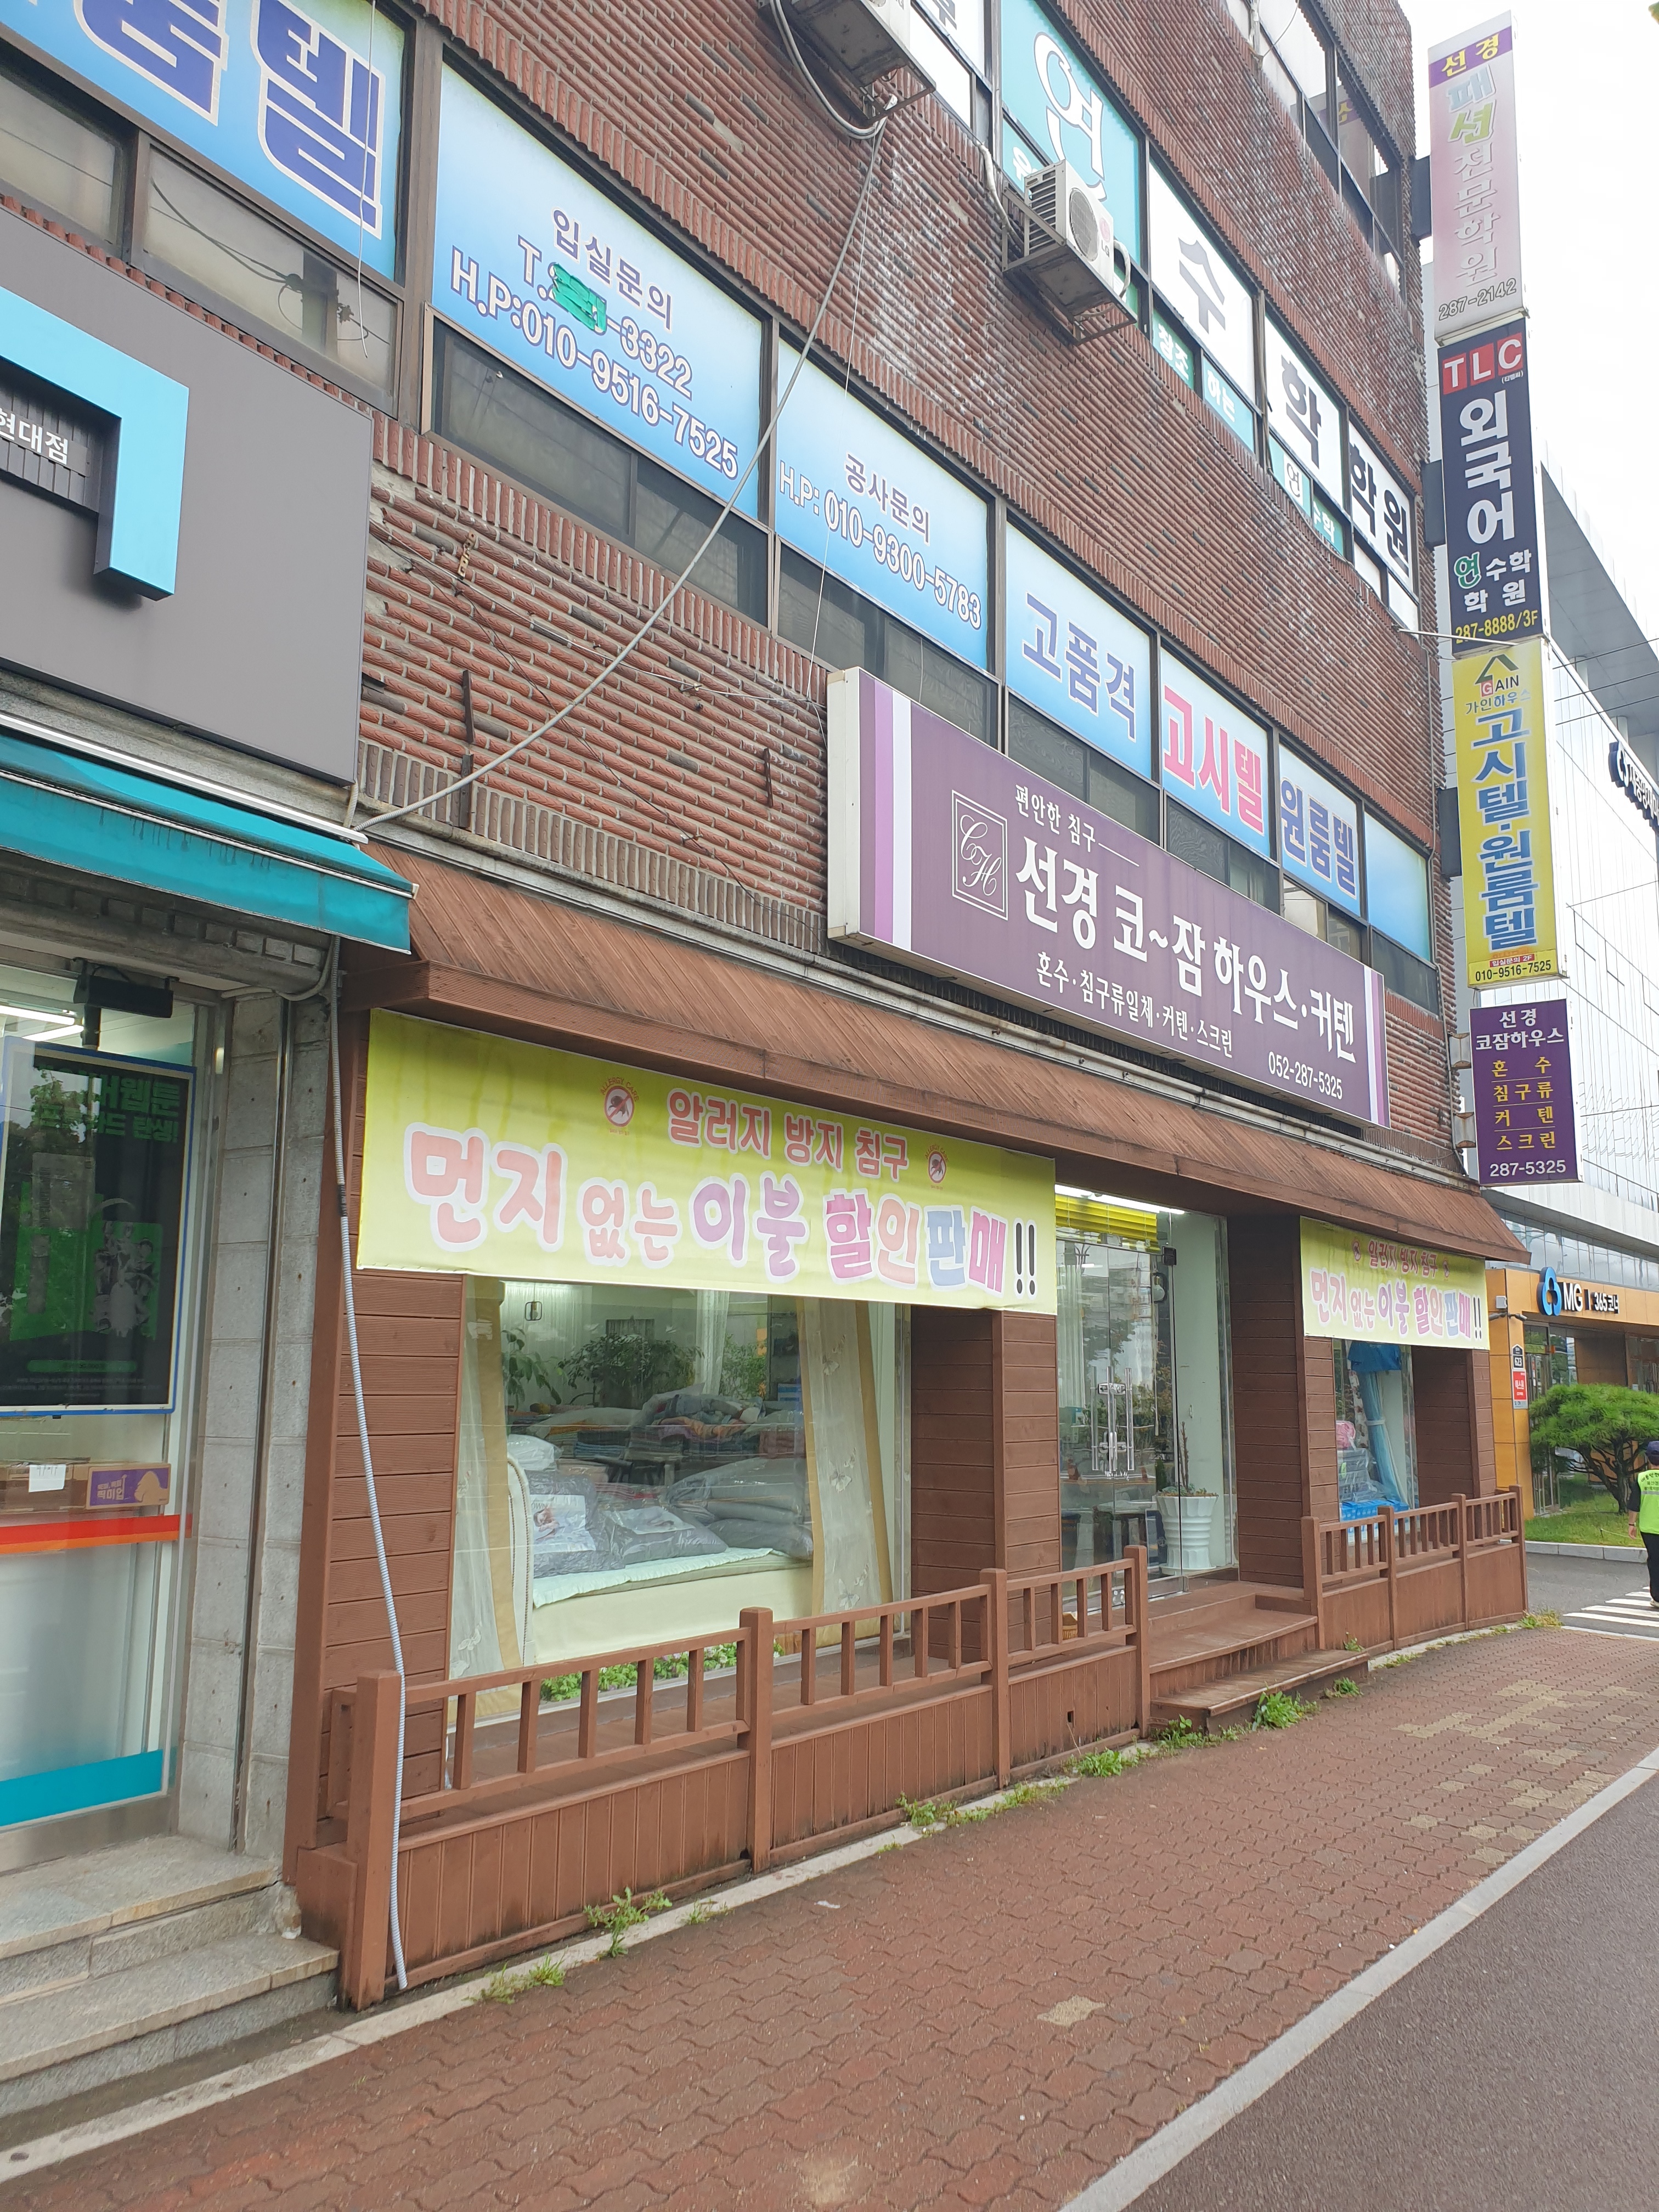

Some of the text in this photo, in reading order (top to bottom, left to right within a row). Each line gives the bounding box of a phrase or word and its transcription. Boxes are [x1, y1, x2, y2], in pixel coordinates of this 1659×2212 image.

[1441, 32, 1500, 78] 선경
[551, 207, 674, 333] 입실문의
[1101, 239, 1110, 258] LG
[1438, 278, 1517, 321] 287-2142
[1444, 338, 1522, 388] TLC
[1207, 369, 1235, 423] 하는
[0, 408, 68, 465] 현대점
[1459, 390, 1515, 544] 외국어
[844, 453, 931, 545] 공사문의
[1350, 442, 1409, 578] 학원
[824, 489, 982, 631] 010-9300-5783
[1464, 579, 1526, 613] 학원
[1455, 610, 1538, 645] 287-8888/3F
[1465, 689, 1531, 714] 가인하우스
[1482, 674, 1519, 696] GAIN
[1022, 591, 1358, 899] 고품격 고시텔 원룸텔
[1471, 708, 1531, 824] 고시텔
[1015, 784, 1096, 853] 편안한 침구
[1479, 829, 1539, 952] 원룸텔
[1015, 836, 1099, 950] 선경
[1310, 989, 1356, 1063] 커텐
[1475, 960, 1551, 981] 010-9516-7525
[1492, 957, 1521, 967] 입실문의
[1036, 951, 1232, 1058] 혼수 침구류일체 커텐 스크린
[1499, 1008, 1537, 1029] 선경
[1475, 1028, 1565, 1051] 코잠하우스
[1268, 1051, 1343, 1100] 052-287-5325
[1493, 1081, 1554, 1102] 침구류
[668, 1091, 909, 1180] 알러지 방지 침구
[1496, 1131, 1556, 1150] 스크린
[1489, 1160, 1566, 1177] 287-5325
[410, 1131, 562, 1244] 먼지
[582, 1184, 678, 1261] 없는
[693, 1177, 806, 1277] 이불
[1368, 1240, 1438, 1277] 알러지 방지 침구
[1311, 1270, 1347, 1323] 먼지
[1350, 1290, 1375, 1329] 없는
[1378, 1280, 1409, 1335] 이불
[1564, 1282, 1583, 1312] MG
[1594, 1291, 1620, 1314] 365코너
